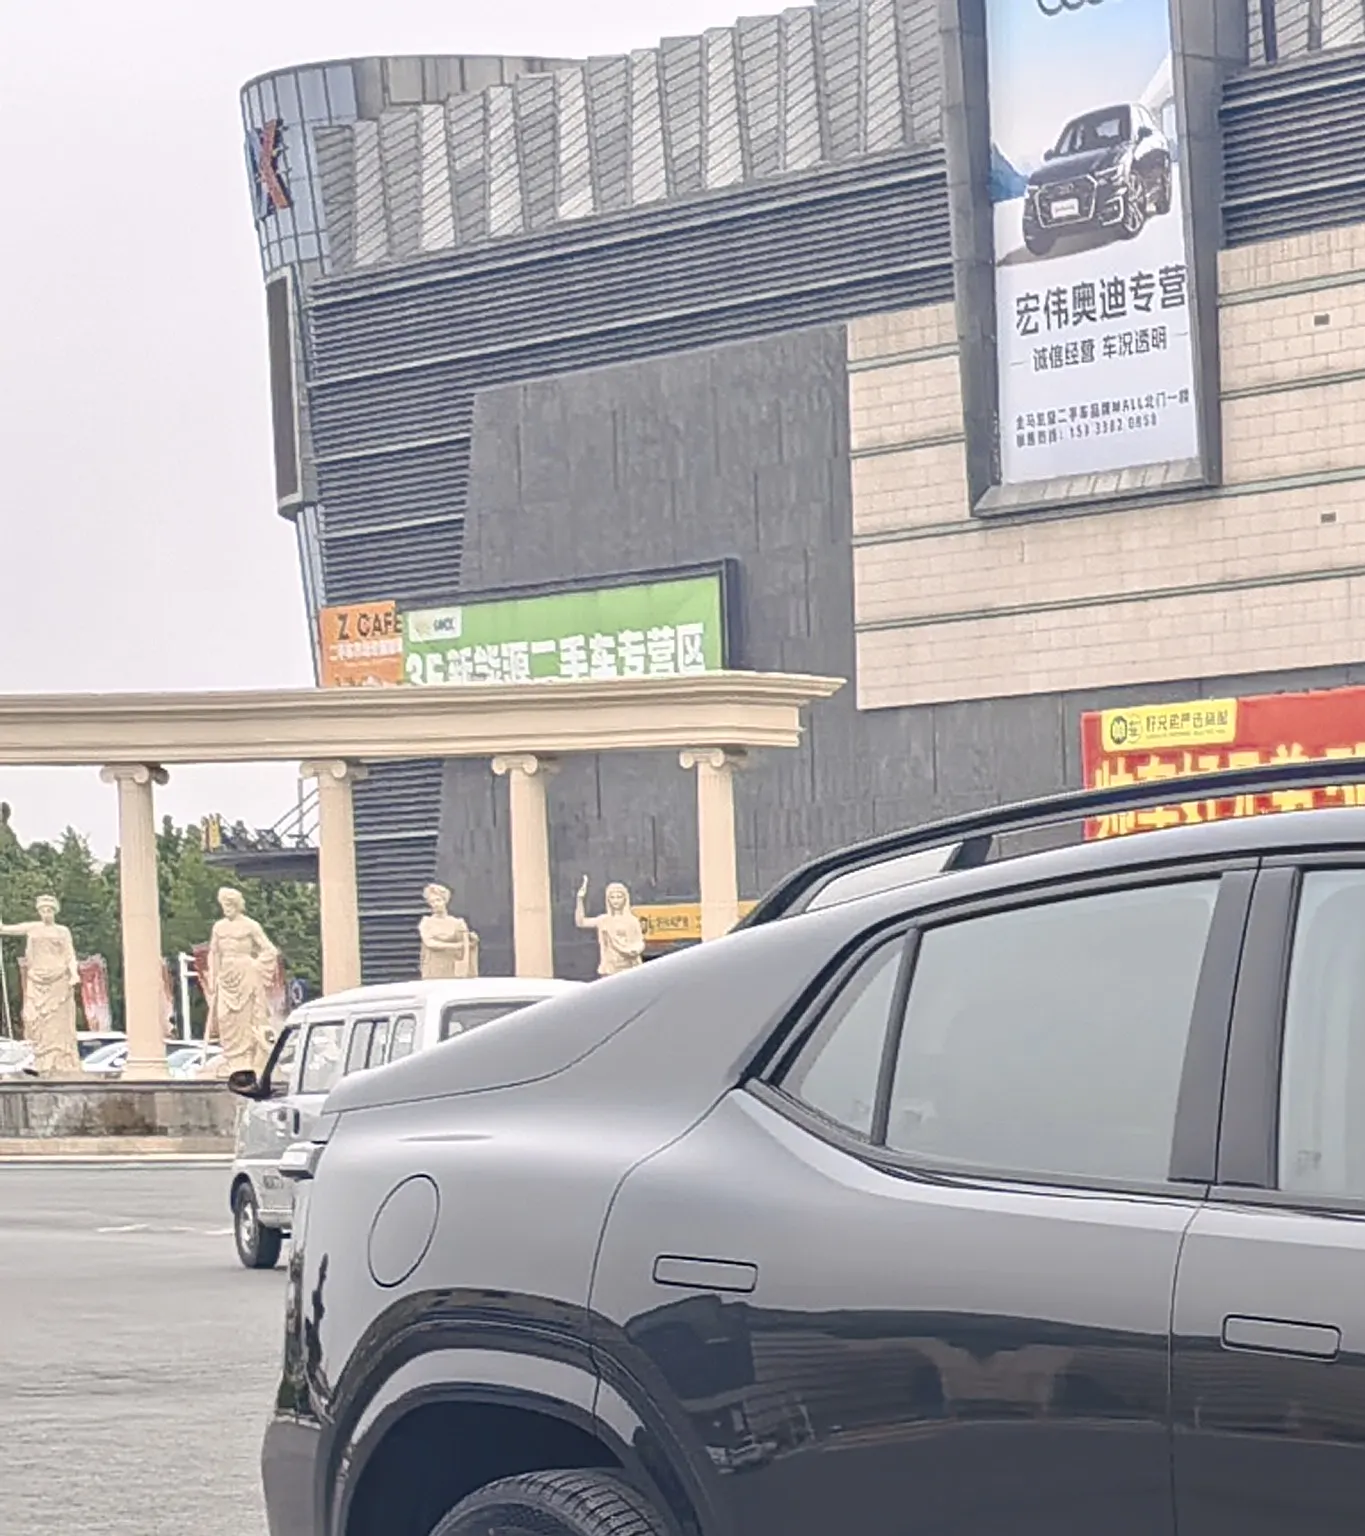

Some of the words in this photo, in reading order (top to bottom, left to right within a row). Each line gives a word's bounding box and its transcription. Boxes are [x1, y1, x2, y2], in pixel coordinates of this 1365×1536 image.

[1015, 264, 1188, 337] 宏伟奥迪专营
[1033, 337, 1096, 372] 诚信经营
[1102, 325, 1168, 359] 车况透明
[338, 612, 352, 641] Z
